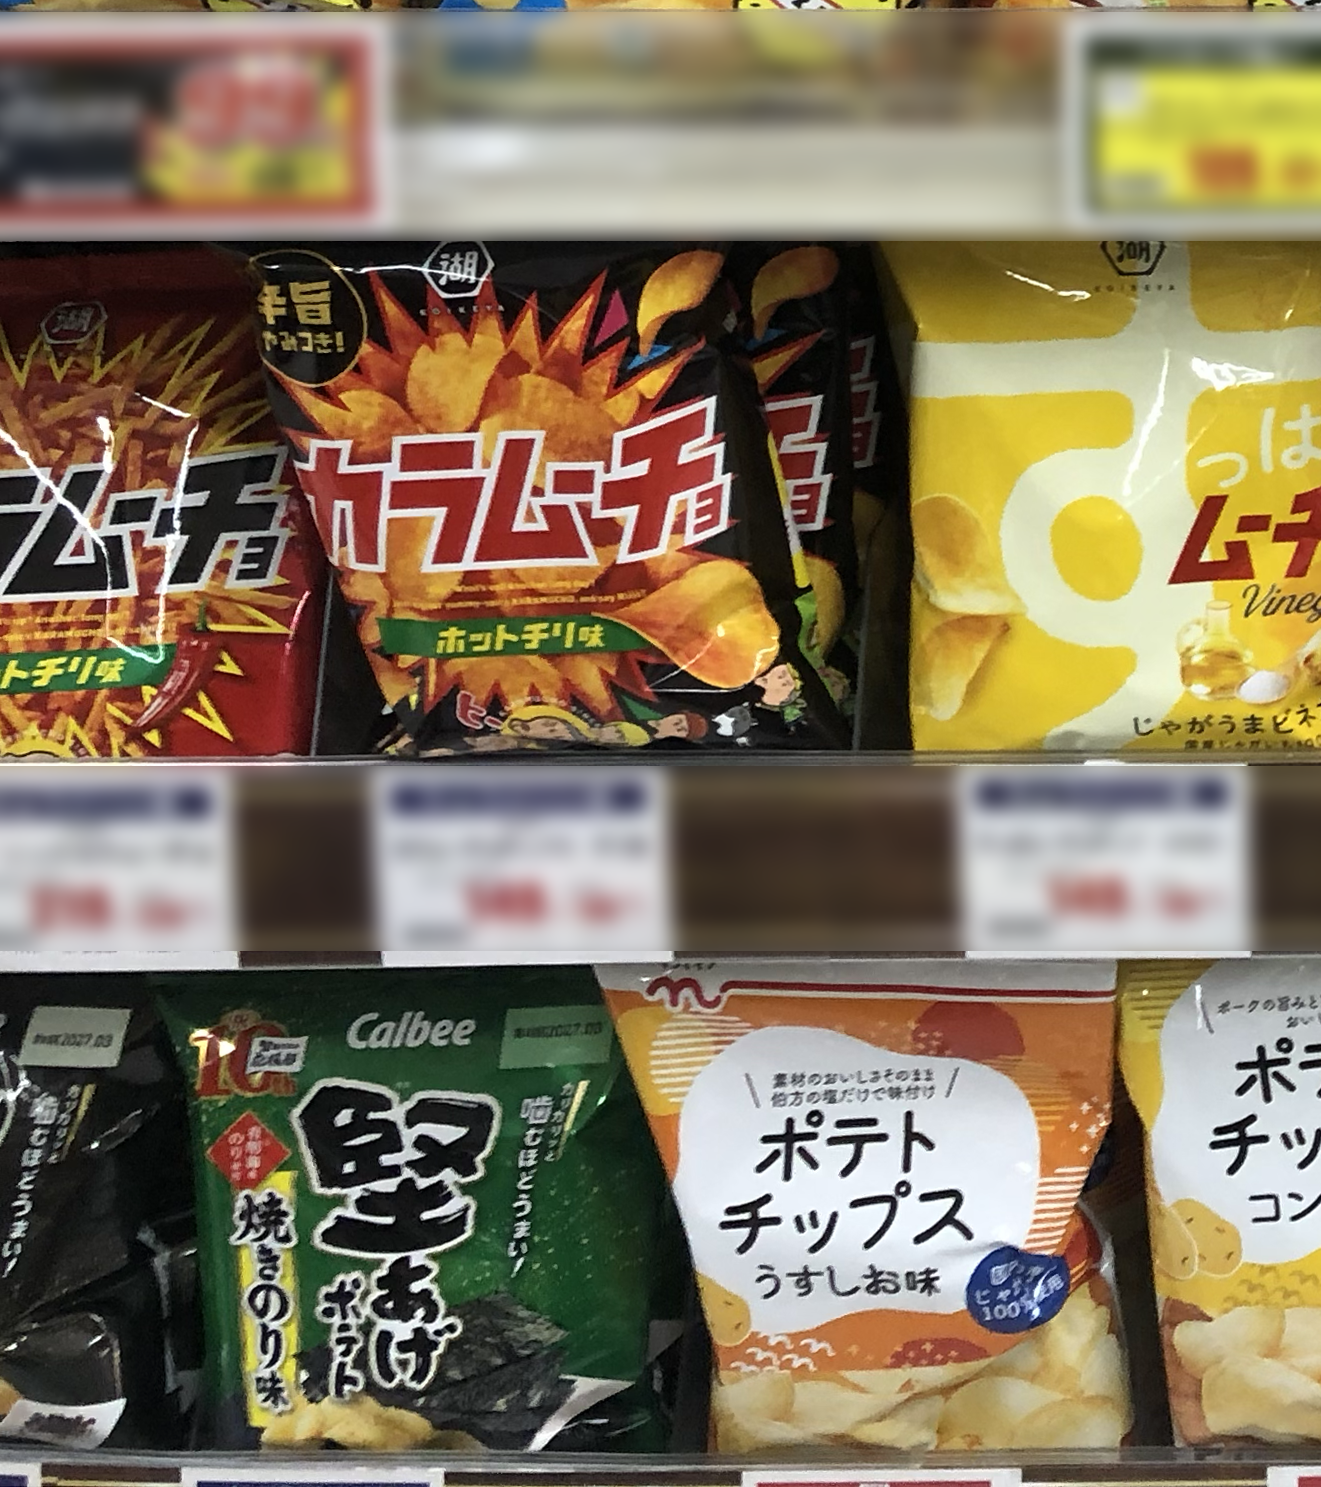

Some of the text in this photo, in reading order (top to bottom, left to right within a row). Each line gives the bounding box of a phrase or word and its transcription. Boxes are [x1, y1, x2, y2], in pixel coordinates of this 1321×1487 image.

[294, 397, 733, 572] カラムーチョ
[437, 625, 605, 653] ホットチリ味
[346, 1013, 475, 1049] Calbee
[756, 1110, 934, 1182] ポテト
[719, 1181, 973, 1254] チップス
[231, 1190, 296, 1412] 焼きのり味
[755, 1265, 940, 1299] うすしお味
[318, 1272, 366, 1399] ポテト
